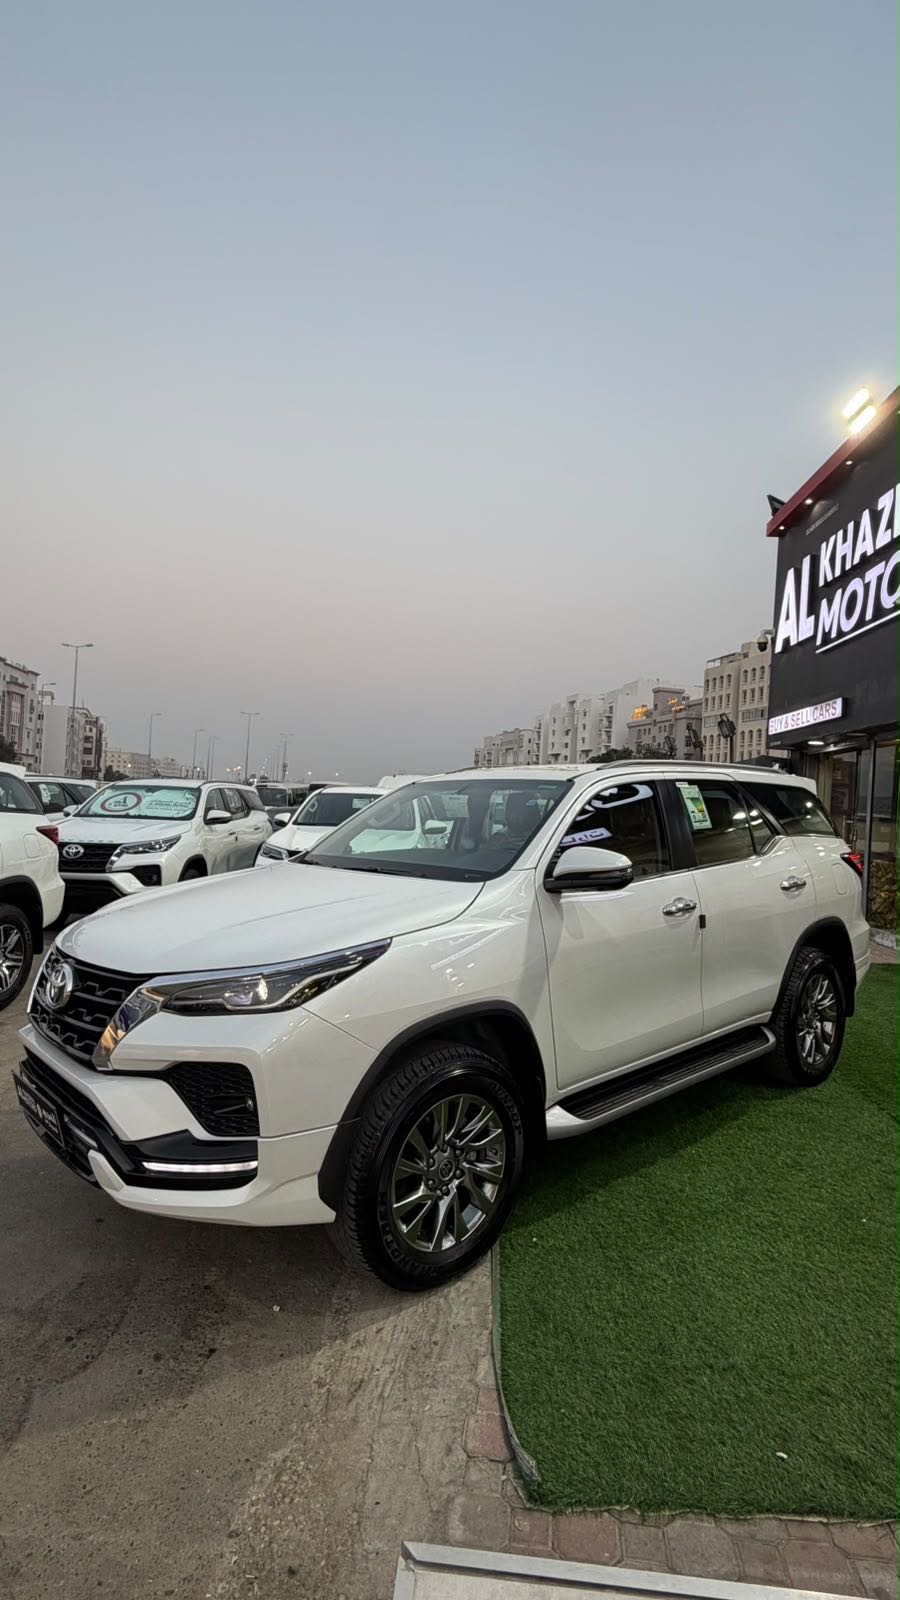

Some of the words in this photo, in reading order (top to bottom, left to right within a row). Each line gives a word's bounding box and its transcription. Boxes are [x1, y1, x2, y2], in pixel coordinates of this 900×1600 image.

[774, 554, 815, 654] AL
[816, 549, 900, 646] MOTO
[769, 717, 784, 733] BUY
[791, 709, 810, 727] SELL
[812, 700, 838, 721] CARS
